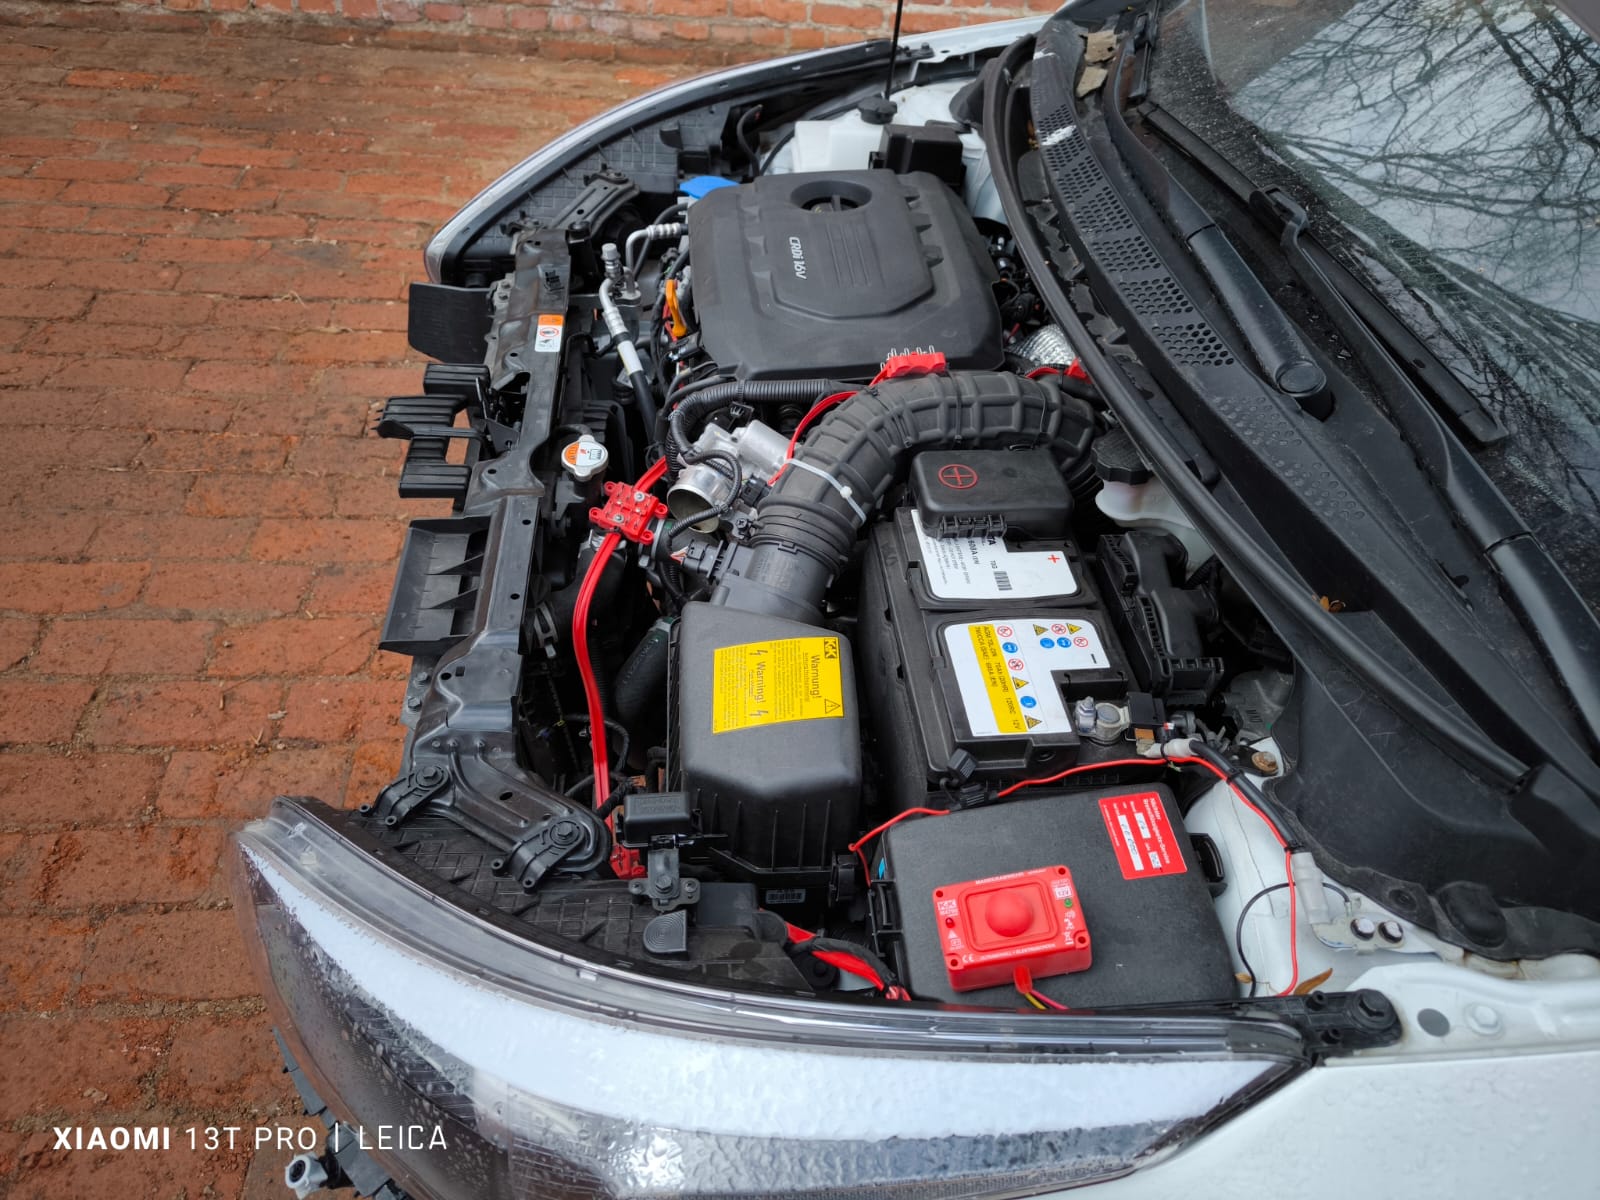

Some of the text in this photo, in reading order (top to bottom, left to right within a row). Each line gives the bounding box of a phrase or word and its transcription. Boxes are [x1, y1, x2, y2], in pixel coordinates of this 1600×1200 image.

[789, 236, 807, 279] CRDi 16V
[755, 661, 767, 704] Warning!
[810, 654, 822, 699] Warnung!
[1012, 719, 1021, 730] 12V
